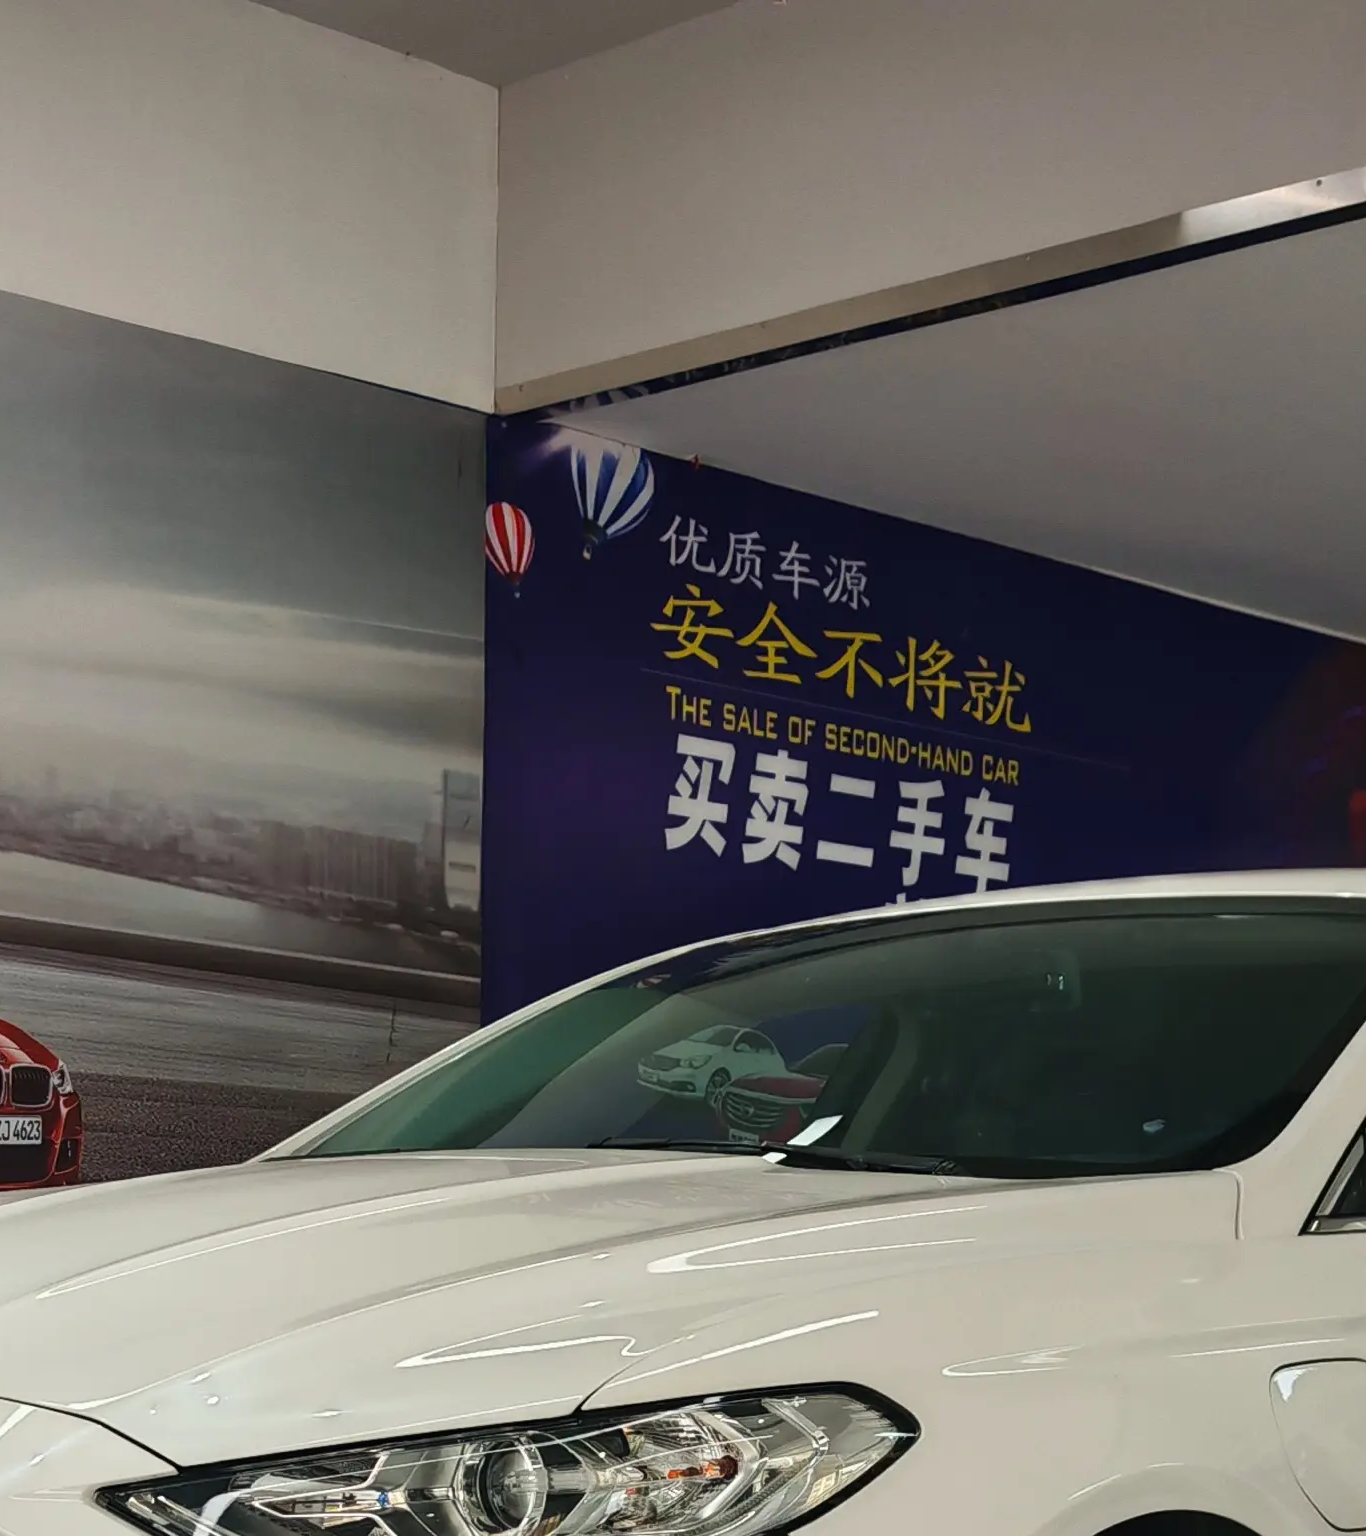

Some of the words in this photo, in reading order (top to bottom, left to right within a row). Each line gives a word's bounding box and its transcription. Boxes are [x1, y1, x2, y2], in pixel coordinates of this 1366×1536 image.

[660, 514, 871, 610] 优质车源
[650, 584, 1032, 733] 安全不将就
[722, 702, 778, 740] SALE
[788, 715, 816, 746] OF
[825, 723, 973, 776] SECOND-HAND
[982, 754, 1019, 786] CAR
[664, 733, 1014, 894] 买卖二手车
